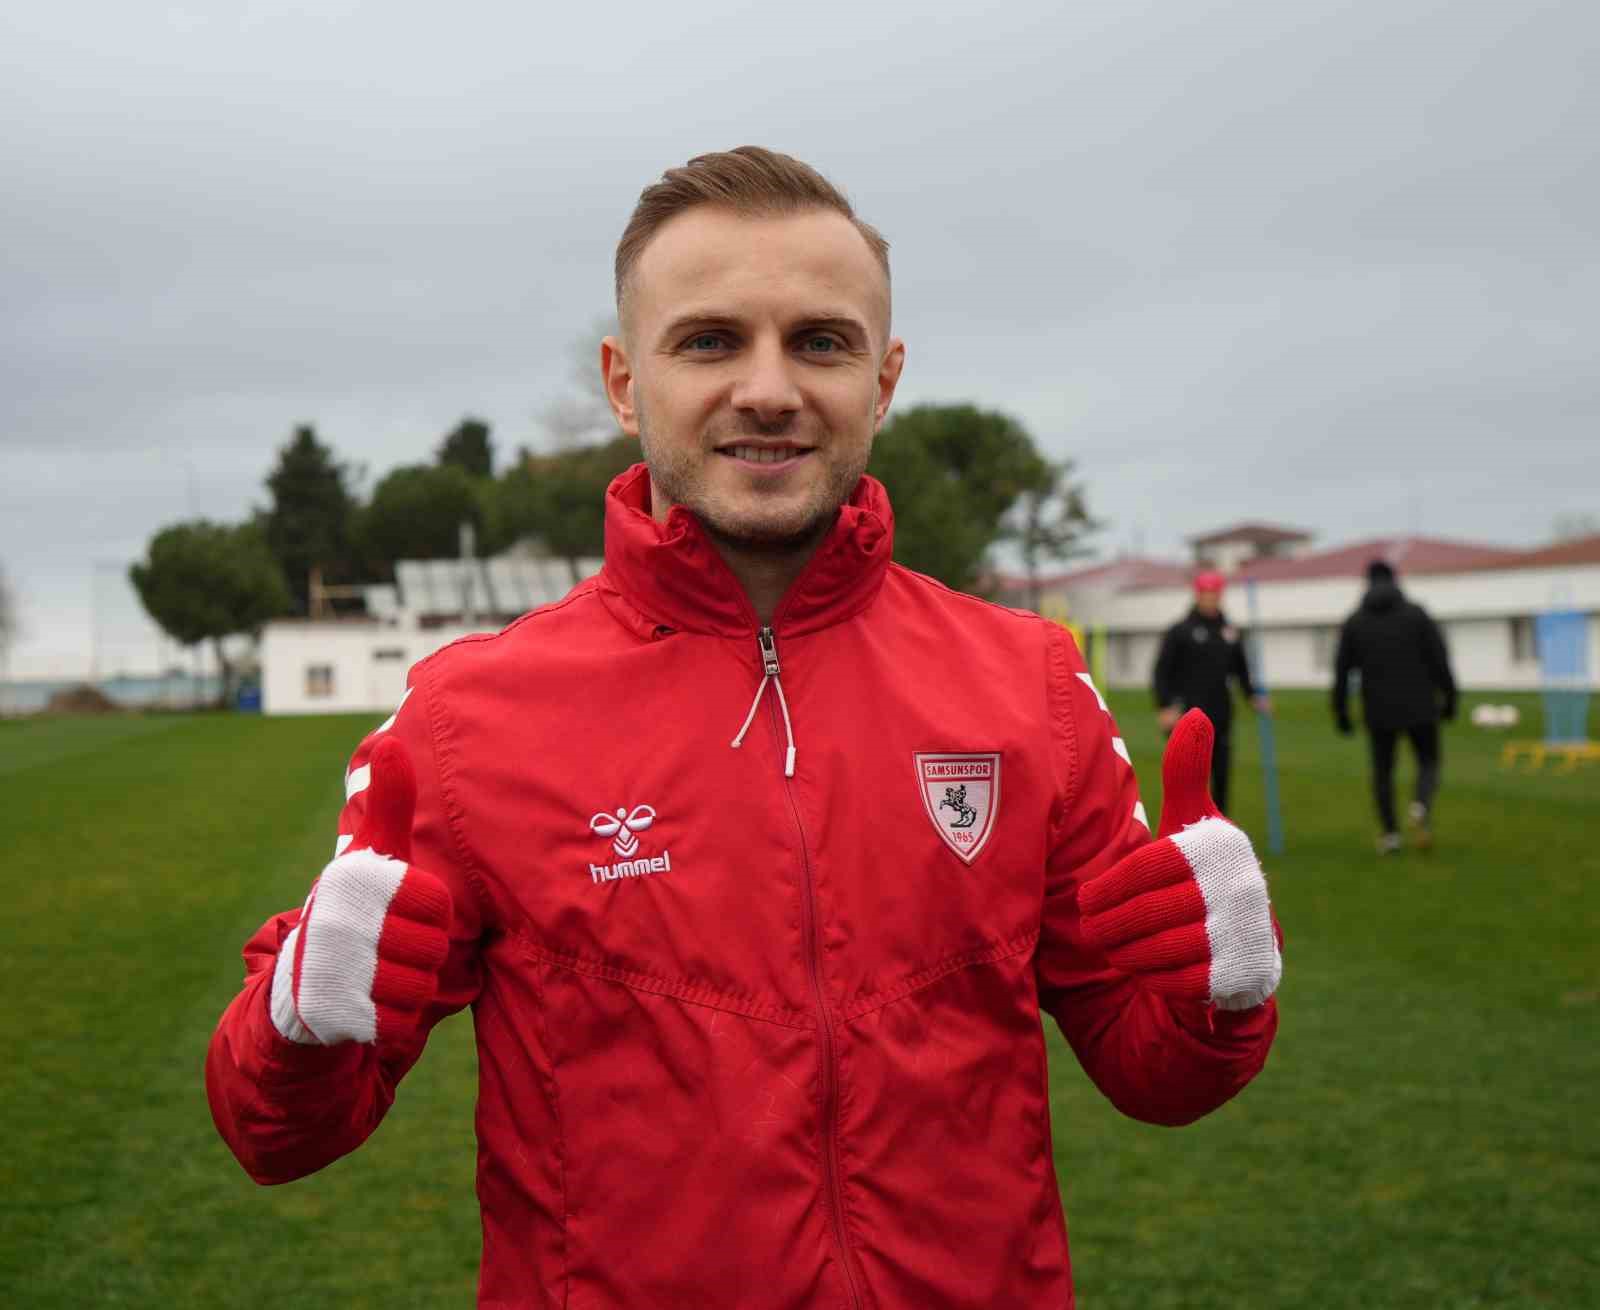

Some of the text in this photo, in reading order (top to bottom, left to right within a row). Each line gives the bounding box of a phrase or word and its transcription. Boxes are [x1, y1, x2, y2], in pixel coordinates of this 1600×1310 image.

[926, 764, 989, 777] SAMSUNSPOR
[952, 831, 974, 843] 1965
[589, 850, 671, 884] hummel
